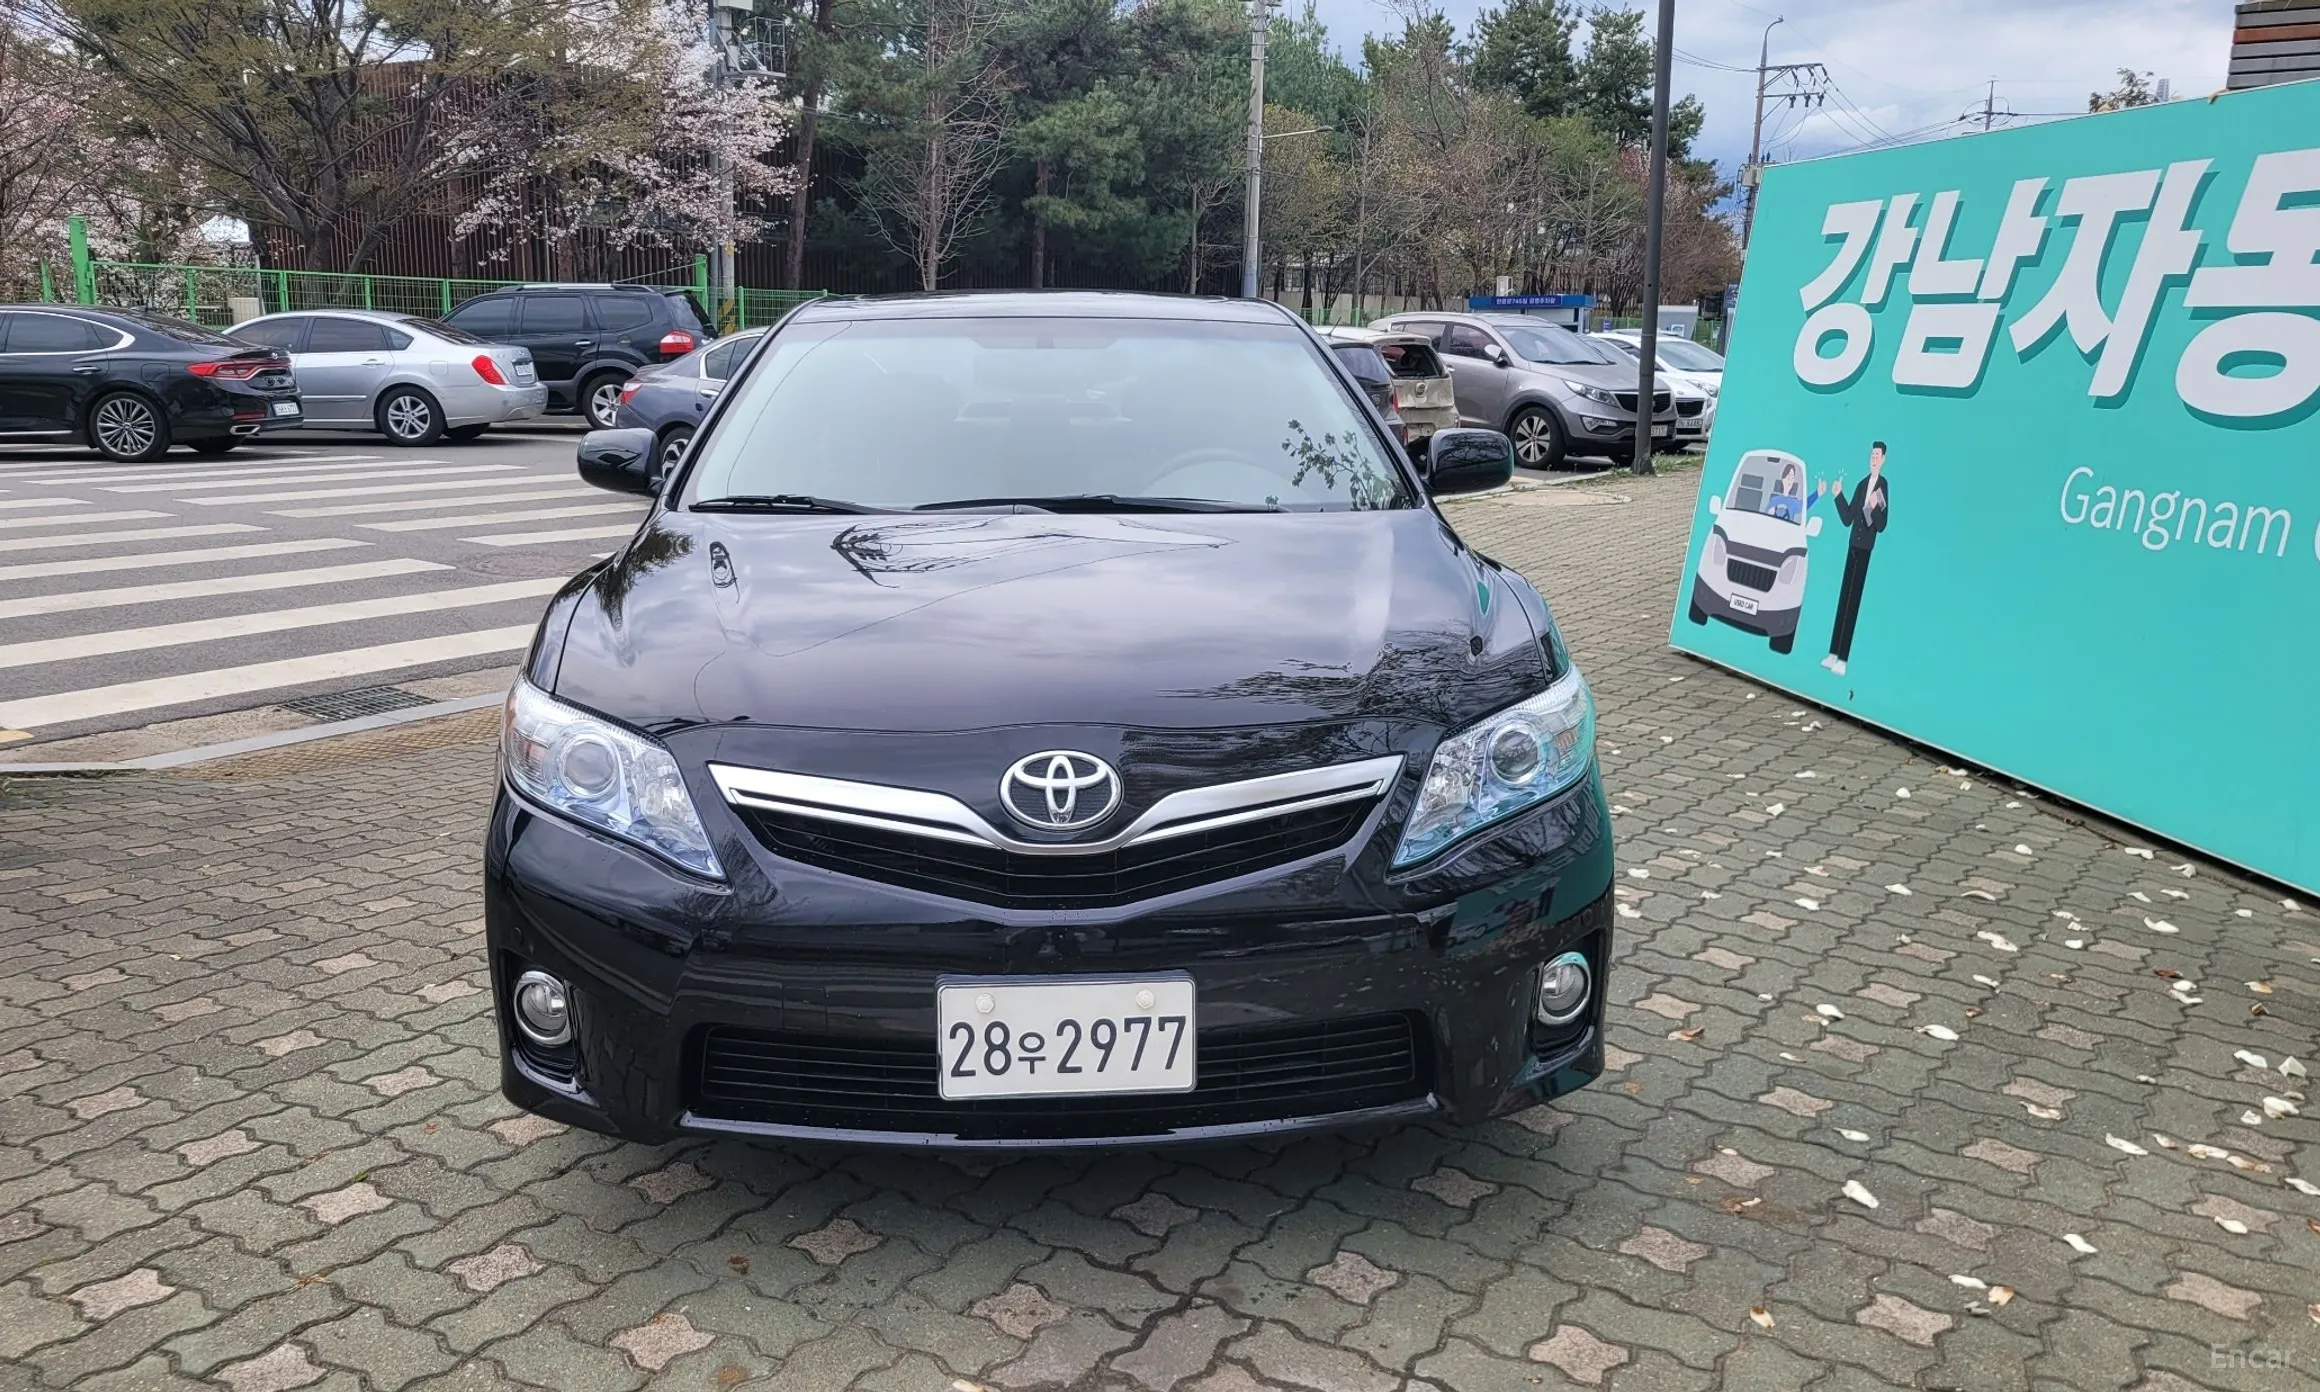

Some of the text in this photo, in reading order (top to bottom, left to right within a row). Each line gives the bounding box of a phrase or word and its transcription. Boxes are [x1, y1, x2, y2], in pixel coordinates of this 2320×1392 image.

[2060, 466, 2291, 558] Gangnam
[1745, 601, 1755, 610] CAR
[949, 1016, 1186, 1077] 28우2977
